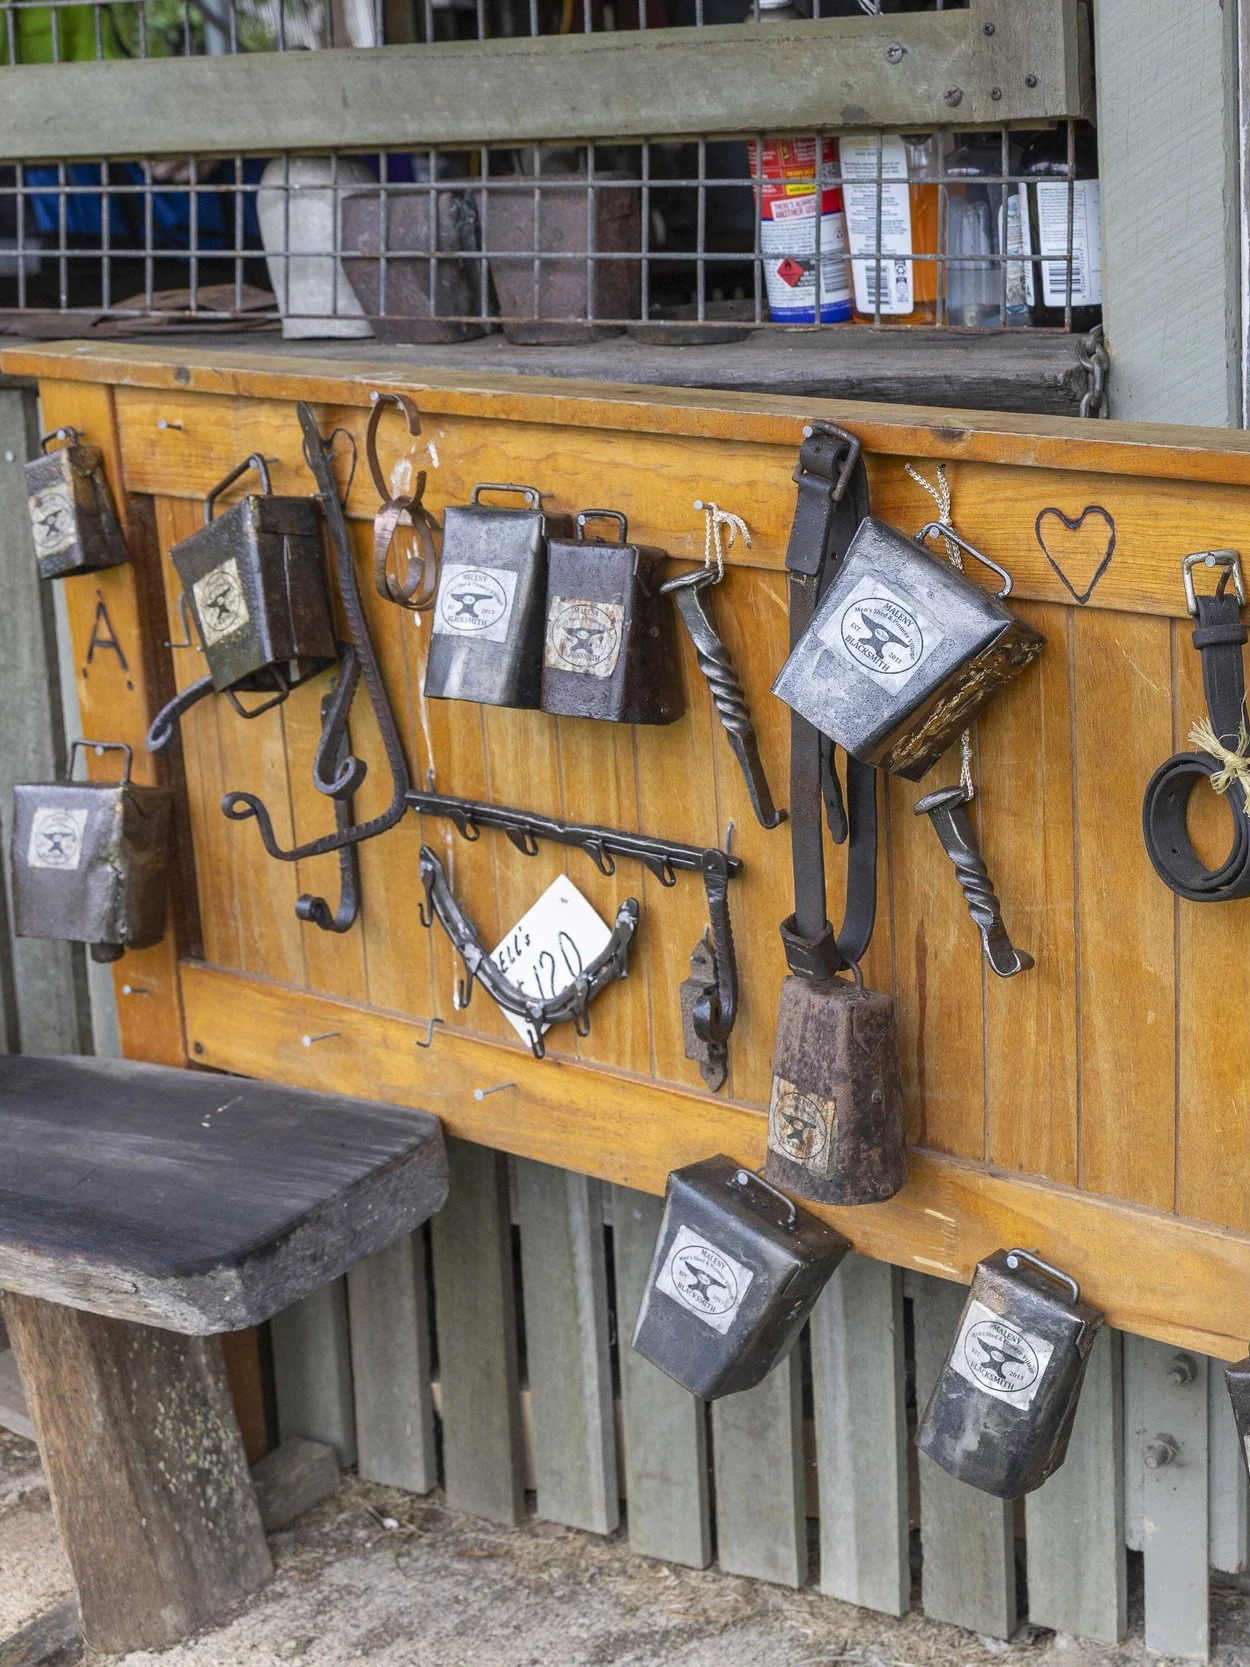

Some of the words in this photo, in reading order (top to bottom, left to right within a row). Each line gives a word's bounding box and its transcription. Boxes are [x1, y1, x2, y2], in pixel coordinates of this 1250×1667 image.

[873, 608, 888, 618] Shed
[892, 618, 910, 640] Pioneer
[883, 602, 914, 628] MALENY
[845, 634, 890, 672] BLACKSMITH
[888, 651, 903, 665] 2013
[499, 925, 531, 974] ELL's
[701, 1248, 726, 1270] MALENY
[677, 1282, 717, 1313] BLACKSMITH
[992, 1324, 1023, 1345] MALENY
[970, 1360, 1015, 1391] BLACKSMITH
[1009, 1370, 1024, 1381] 2013
